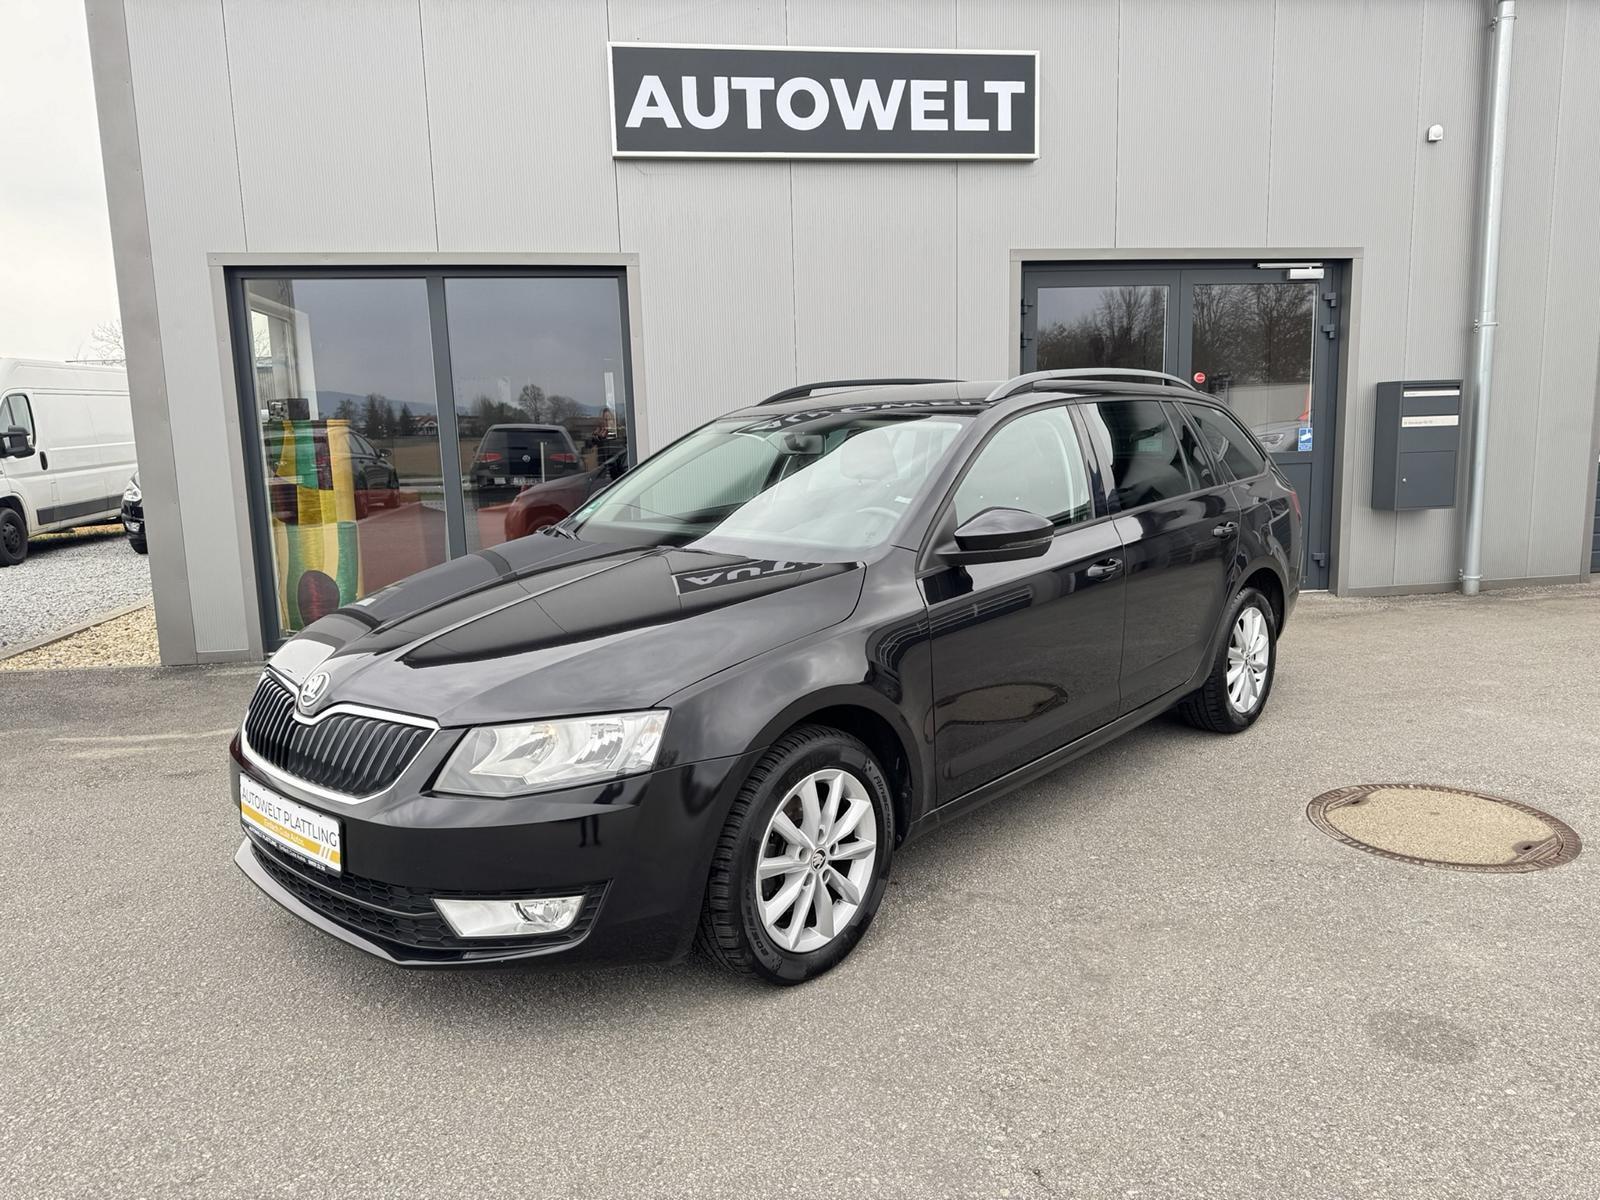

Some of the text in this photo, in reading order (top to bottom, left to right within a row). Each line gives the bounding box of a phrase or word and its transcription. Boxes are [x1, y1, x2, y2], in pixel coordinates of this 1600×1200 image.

[625, 75, 1025, 132] AUTOWELT
[242, 788, 281, 820] AUTOWELT
[284, 811, 337, 847] PLATTLING
